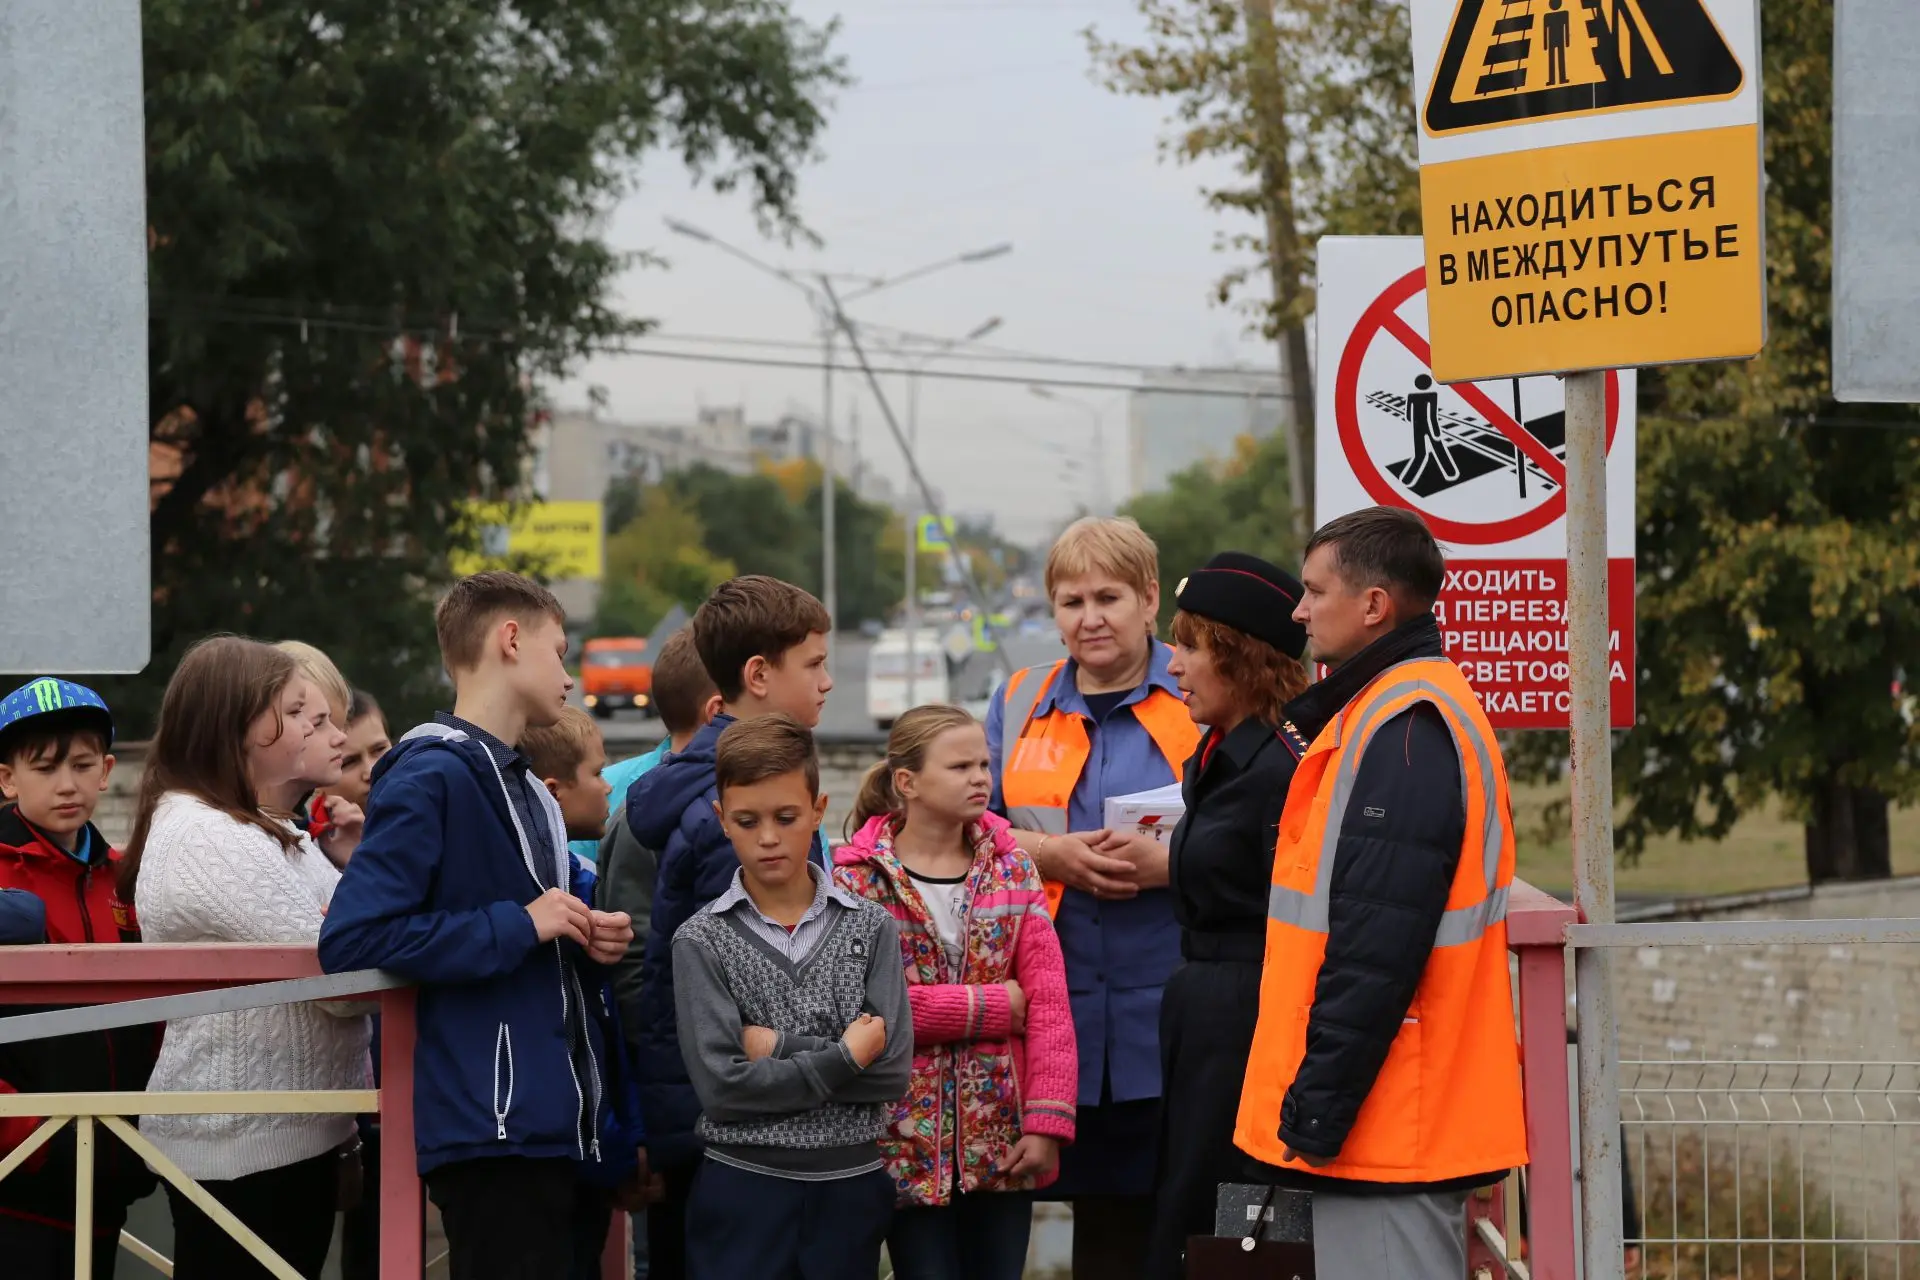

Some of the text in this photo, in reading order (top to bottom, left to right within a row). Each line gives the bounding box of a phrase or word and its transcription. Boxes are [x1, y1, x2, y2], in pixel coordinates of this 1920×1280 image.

[1451, 175, 1716, 236] НАХОДИТЬСЯ
[1439, 223, 1740, 286] В МЕЖДУПУТЬЕ
[1491, 280, 1668, 328] ОПАСНО!
[1440, 569, 1556, 596] ХОДИТЬ
[1458, 661, 1627, 683] СВЕТОФА
